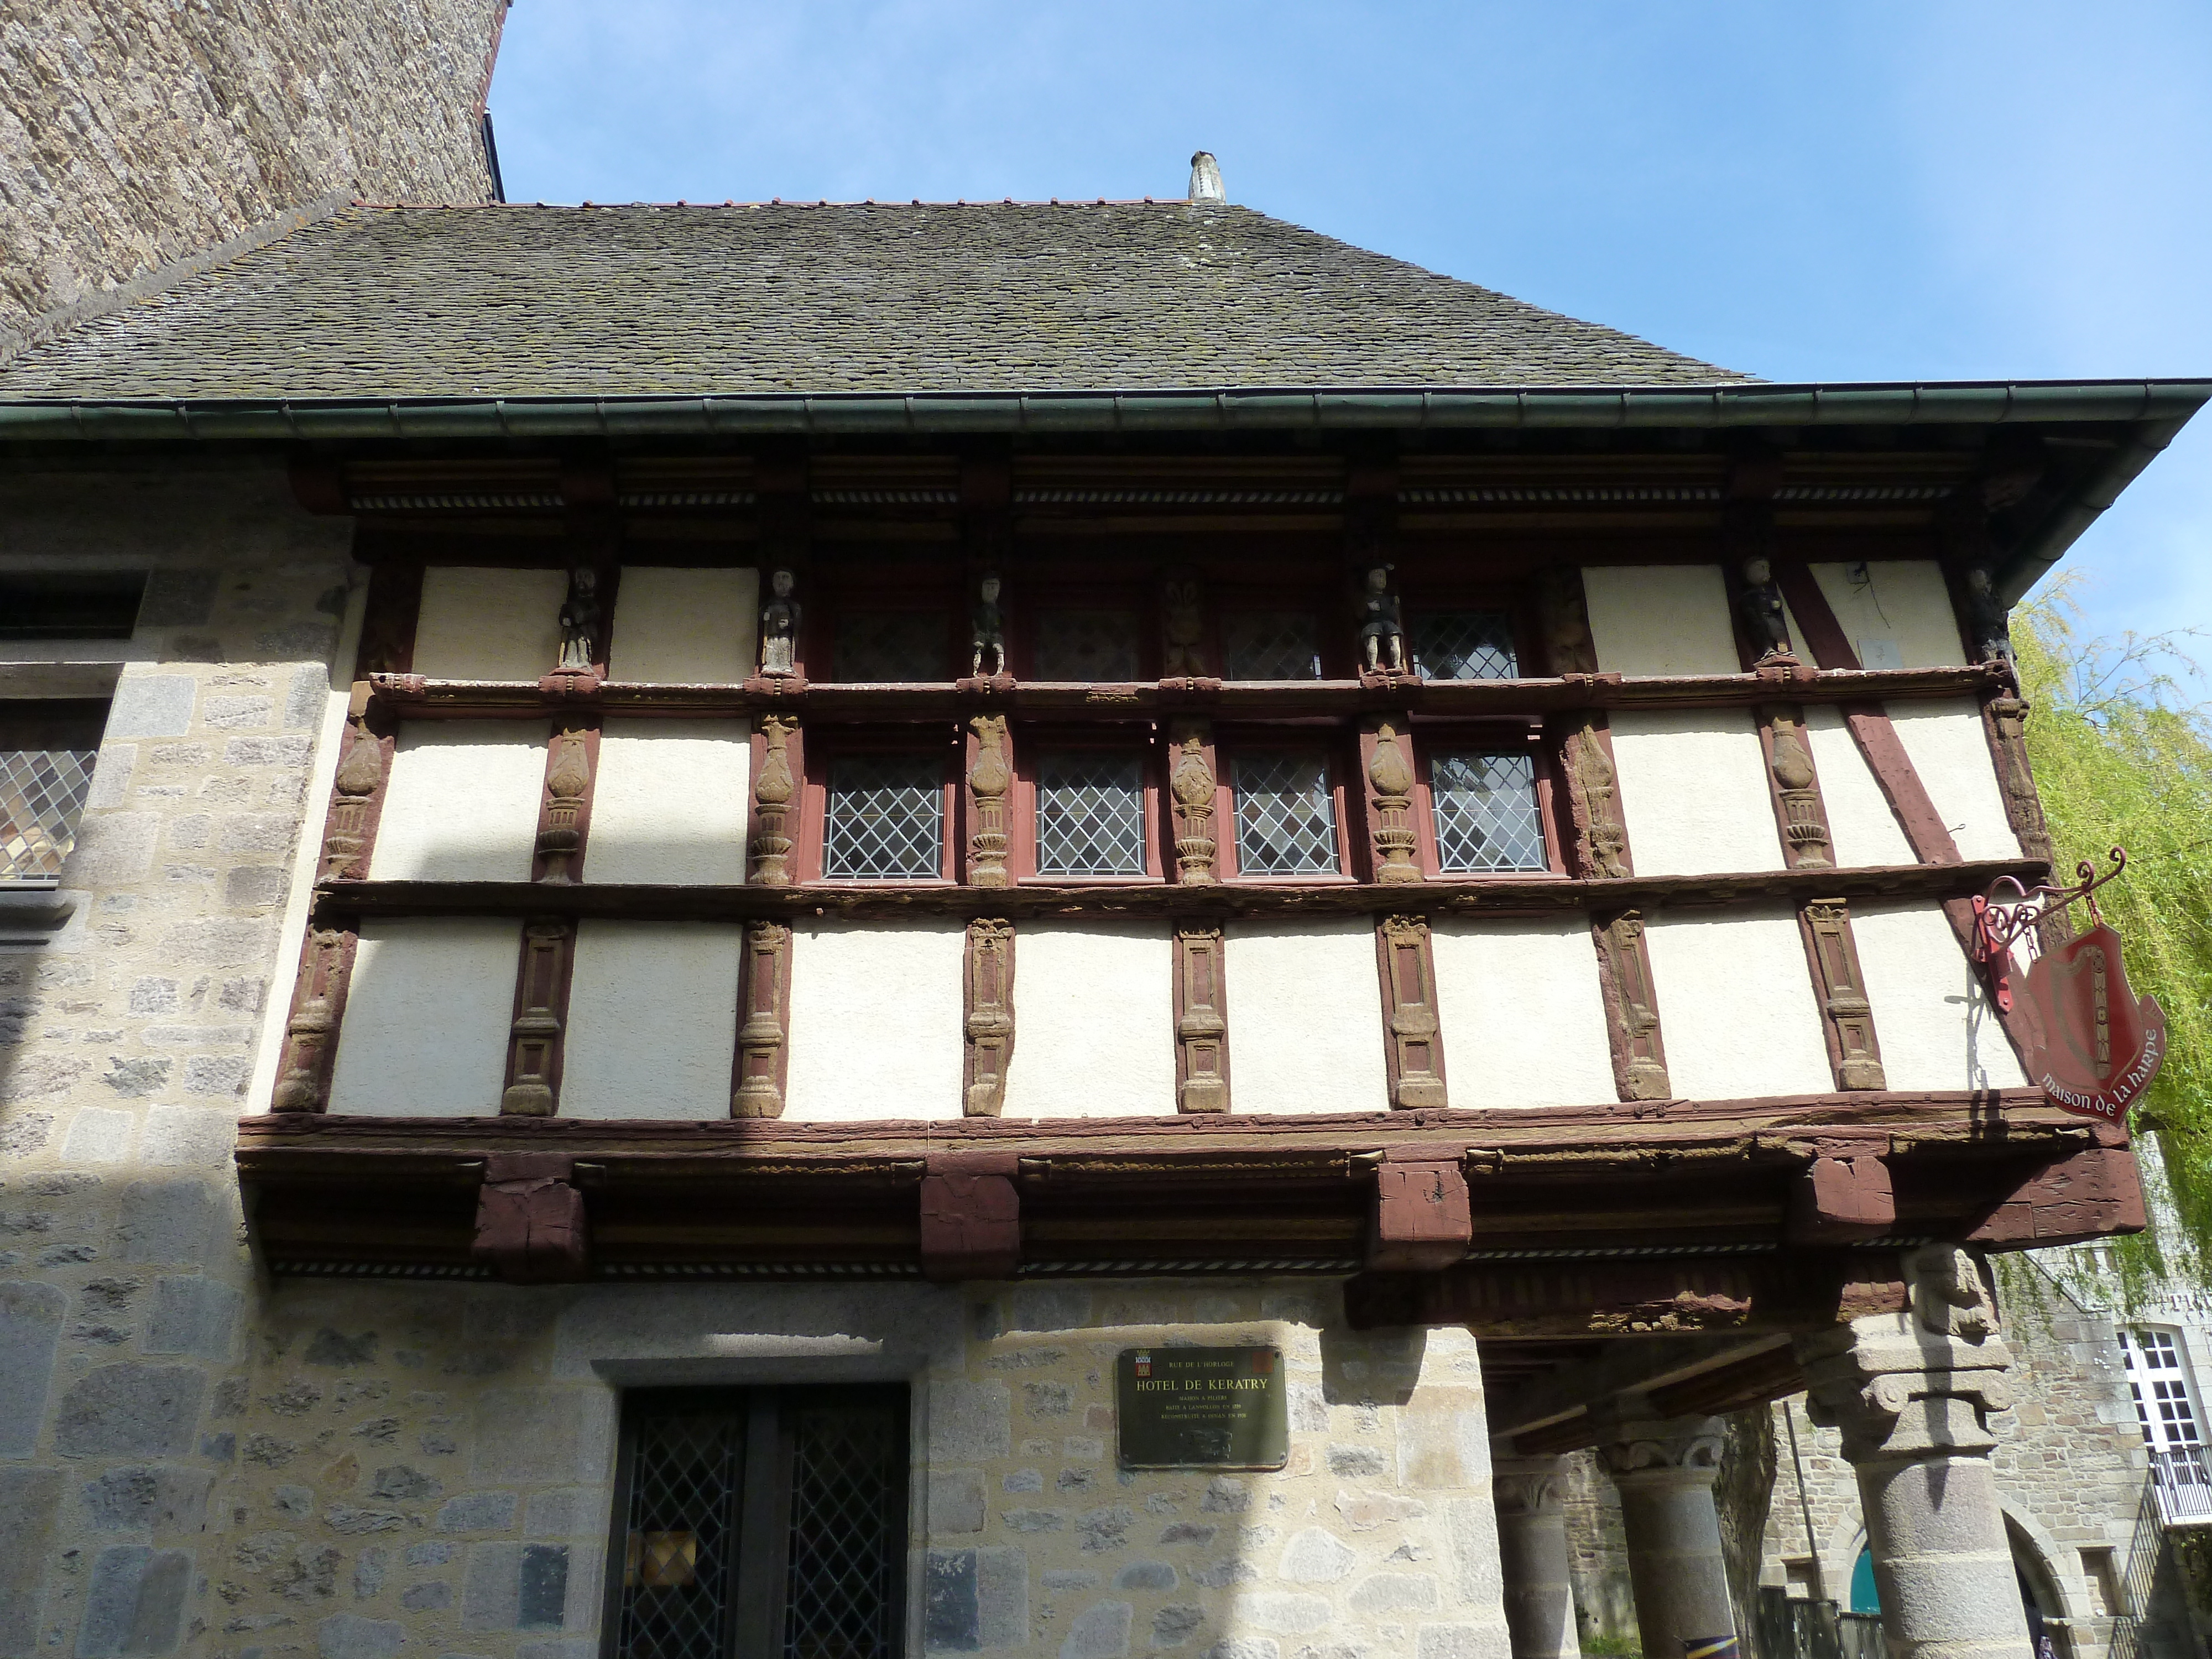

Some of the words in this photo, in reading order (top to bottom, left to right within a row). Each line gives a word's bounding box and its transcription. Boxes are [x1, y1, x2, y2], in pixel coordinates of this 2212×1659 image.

[2042, 1072, 2090, 1109] maison
[2095, 1094, 2116, 1116] de
[2112, 1085, 2132, 1103] la
[1136, 1380, 1178, 1391] HOTEL
[1185, 1379, 1202, 1390] DE
[1208, 1378, 1268, 1390] KERATRY
